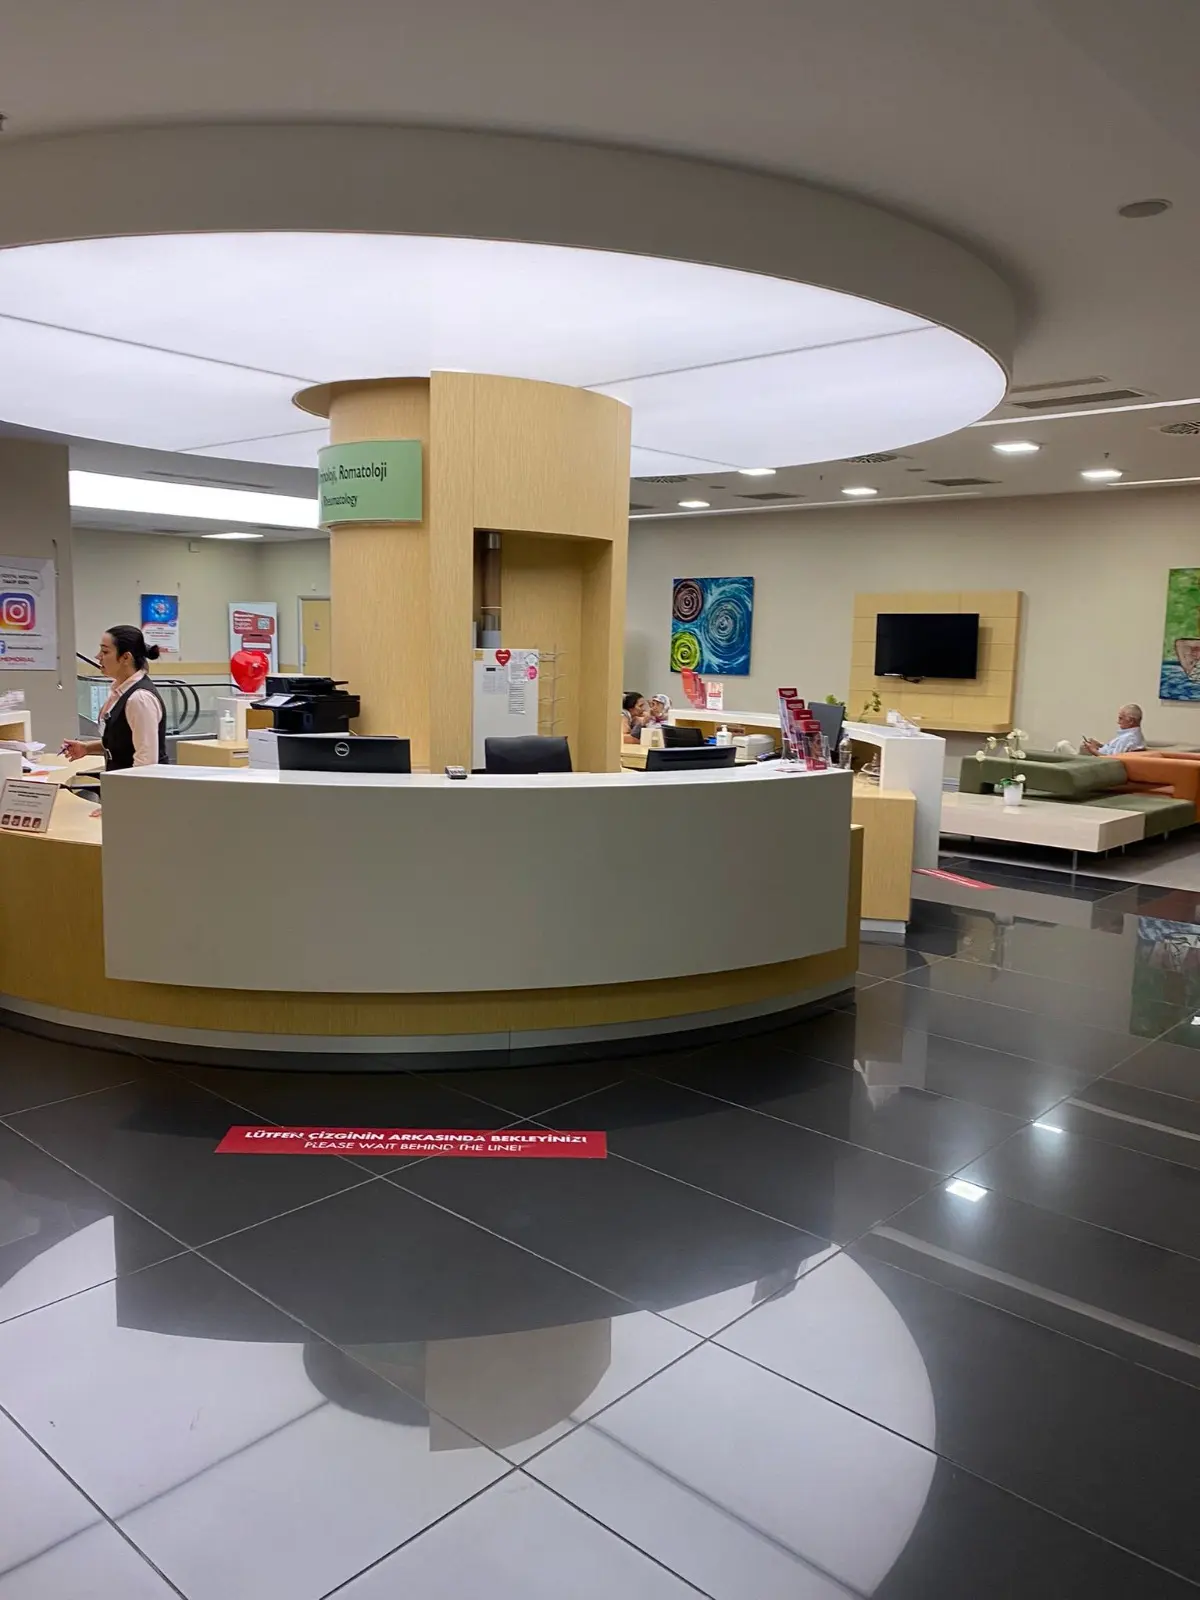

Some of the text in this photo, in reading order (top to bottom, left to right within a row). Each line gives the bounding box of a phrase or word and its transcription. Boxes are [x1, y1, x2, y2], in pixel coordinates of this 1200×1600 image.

[339, 461, 387, 482] Romatoloji
[245, 1130, 304, 1139] LÜTFEN
[308, 1131, 384, 1141] ÇİZGİNİN
[388, 1133, 486, 1142] ARKASINDA
[304, 1141, 355, 1149] PLEASE
